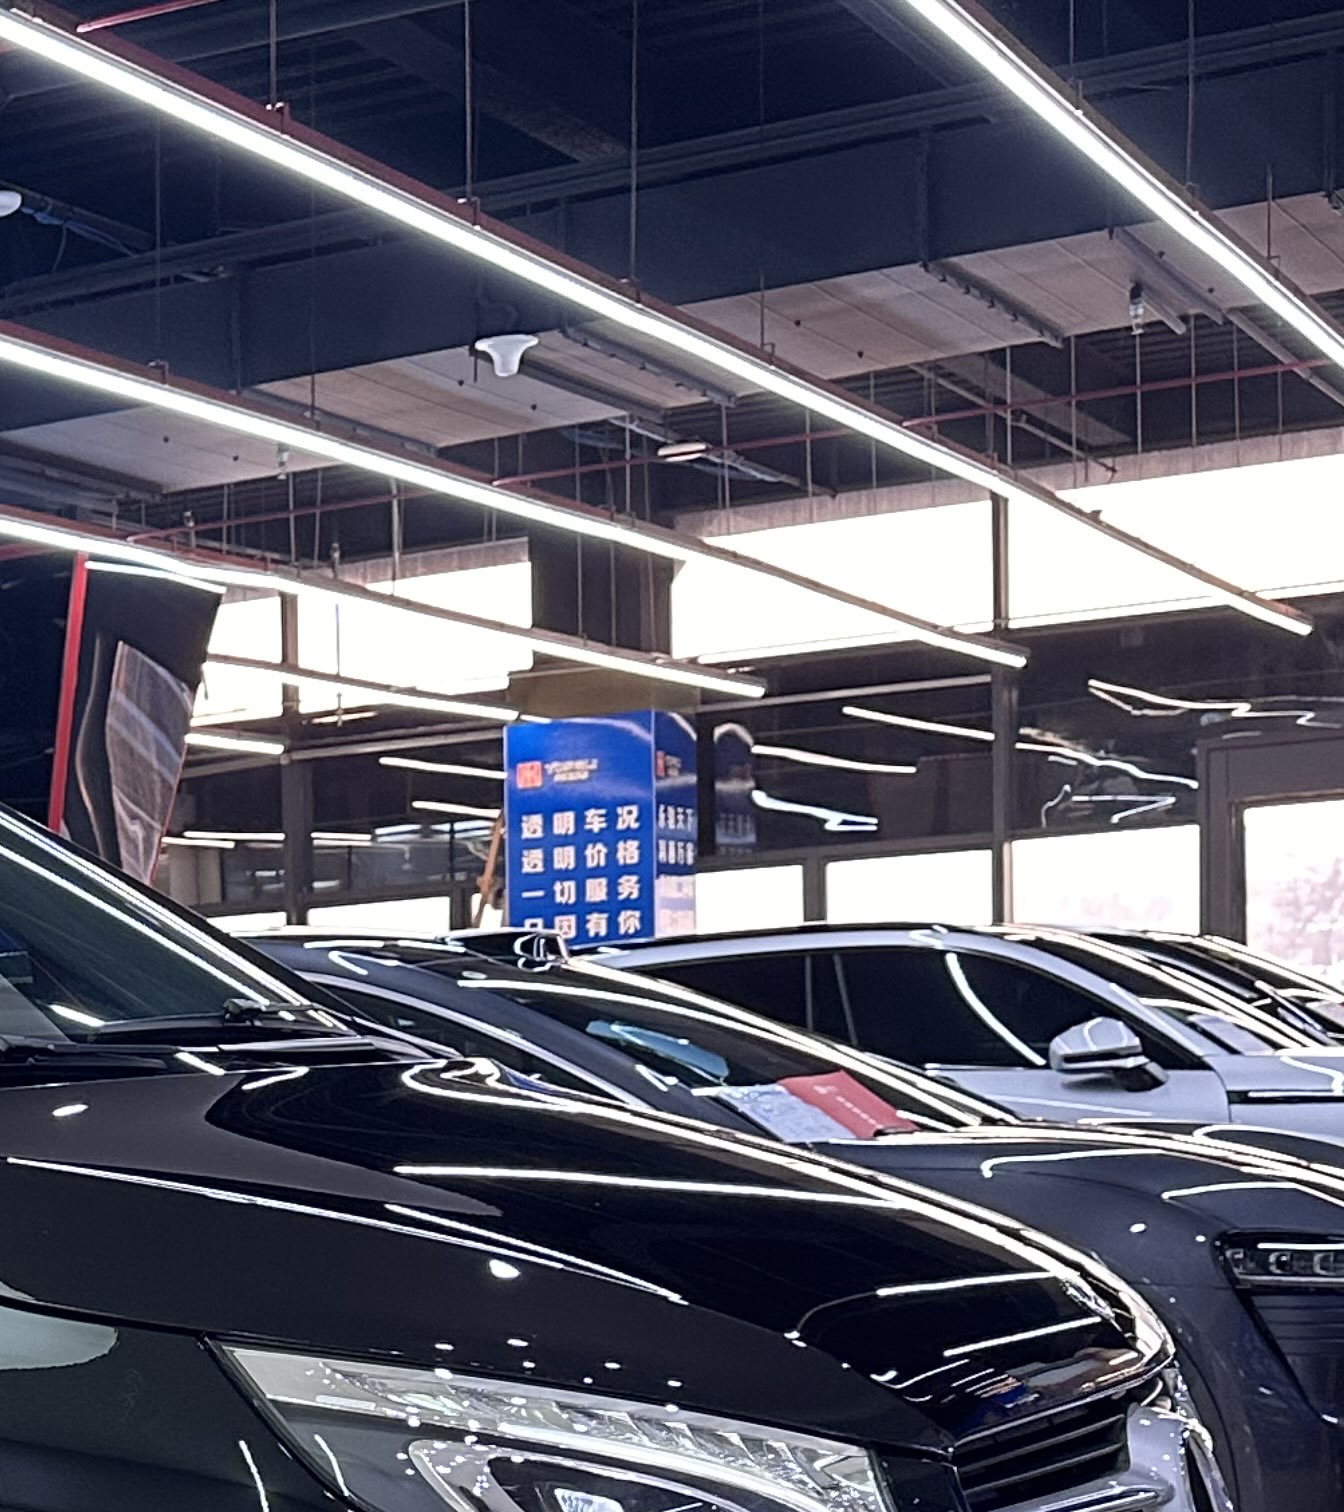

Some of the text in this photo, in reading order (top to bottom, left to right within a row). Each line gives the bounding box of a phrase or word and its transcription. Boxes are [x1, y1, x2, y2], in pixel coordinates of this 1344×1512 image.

[521, 804, 641, 840] 透明车况
[521, 839, 641, 873] 透明价格
[521, 874, 641, 905] 一切服务
